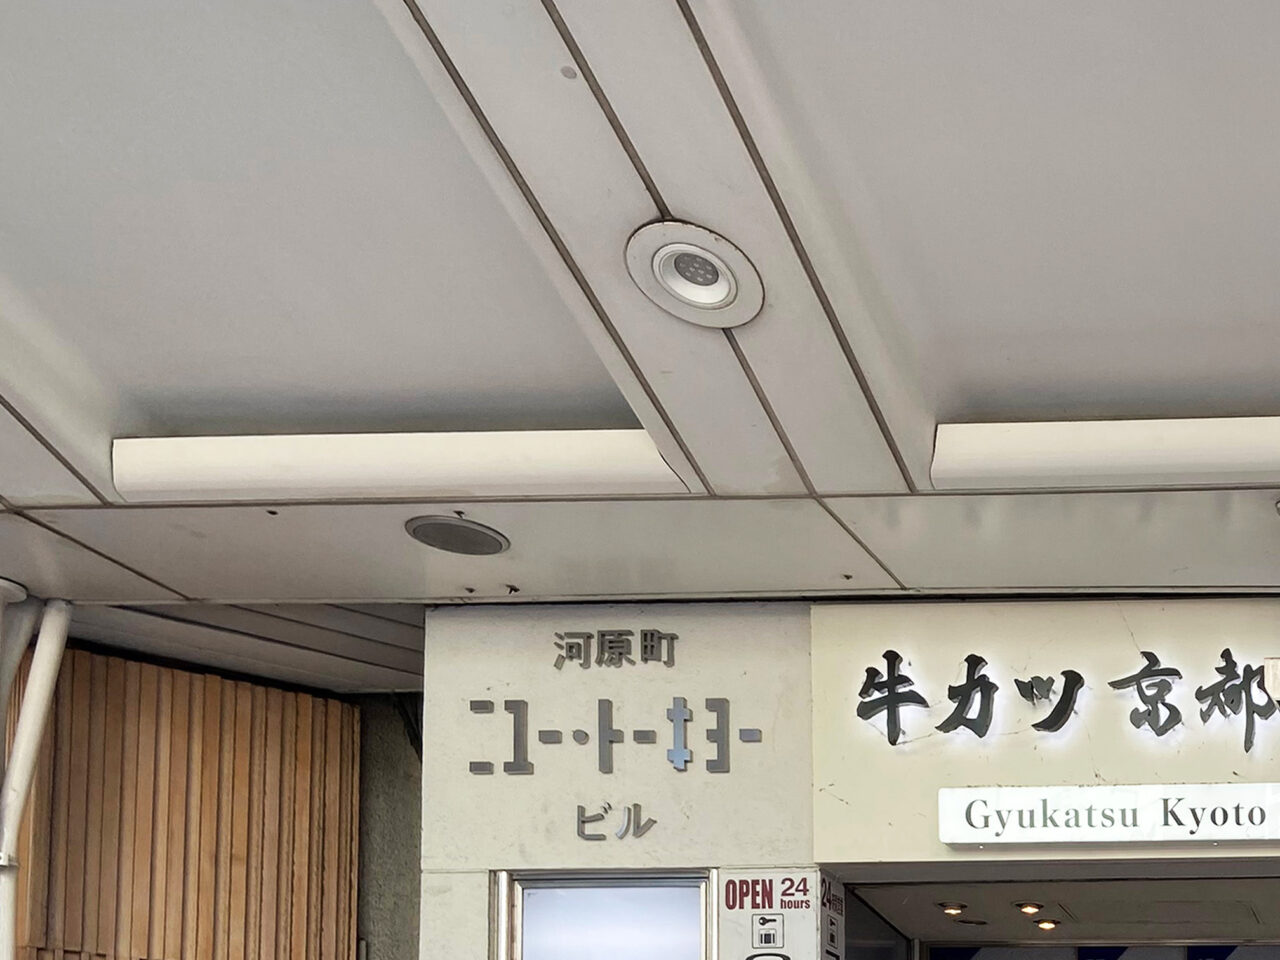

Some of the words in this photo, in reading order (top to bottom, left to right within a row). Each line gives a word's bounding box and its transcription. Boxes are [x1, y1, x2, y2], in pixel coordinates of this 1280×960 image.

[553, 629, 679, 671] 河原町
[577, 801, 657, 841] ビル
[965, 799, 1140, 837] Gyukatsu
[1162, 797, 1267, 834] Kyoto
[725, 879, 773, 910] OPEN
[780, 877, 809, 896] 24
[780, 898, 811, 909] hours
